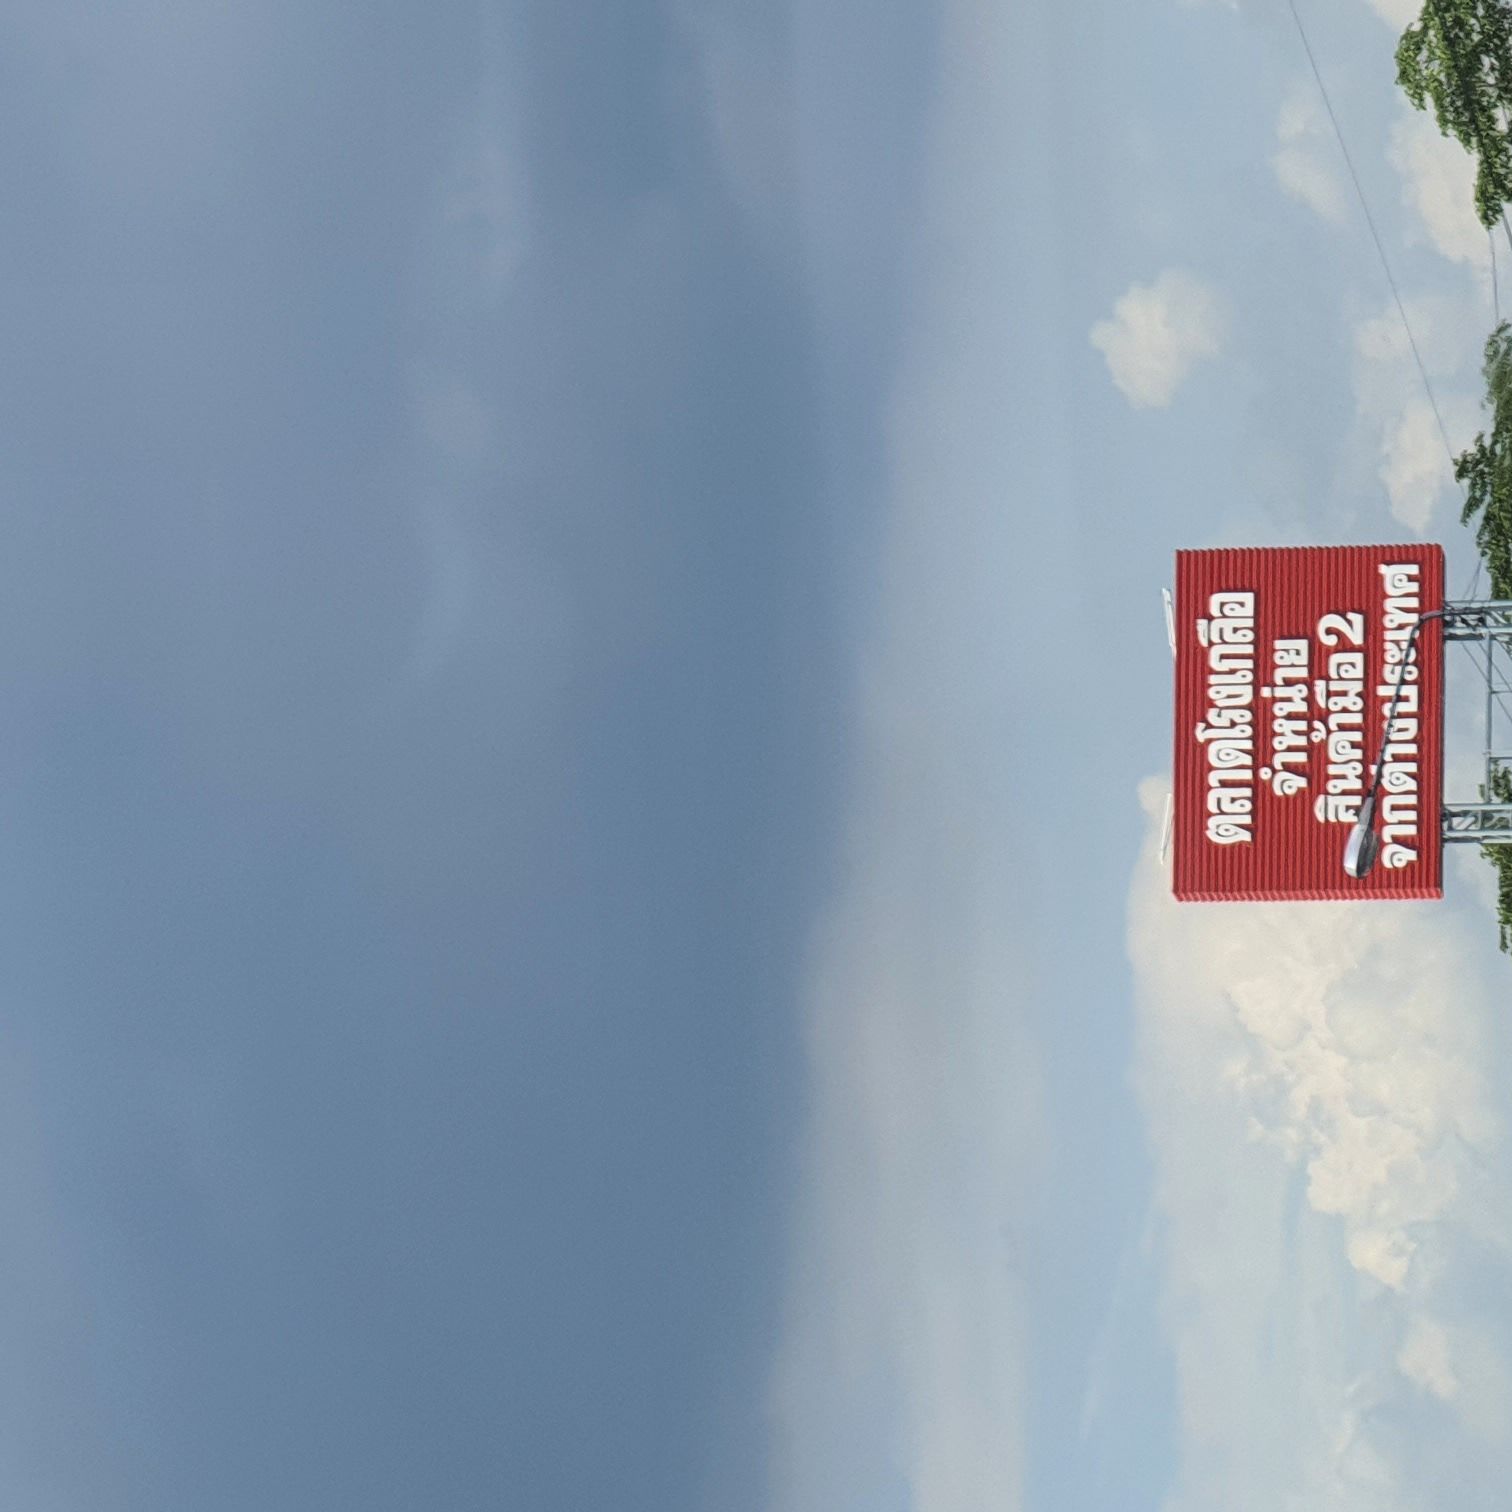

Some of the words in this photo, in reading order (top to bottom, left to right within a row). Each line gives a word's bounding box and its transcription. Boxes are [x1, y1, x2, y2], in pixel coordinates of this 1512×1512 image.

[1317, 611, 1364, 647] 2
[1195, 591, 1254, 845] ตลาดโรงเกลือ
[1259, 638, 1309, 796] จำหน่าย
[1310, 652, 1364, 823] สินค้ามือ
[1370, 563, 1420, 869] จากต่างประเทศ
